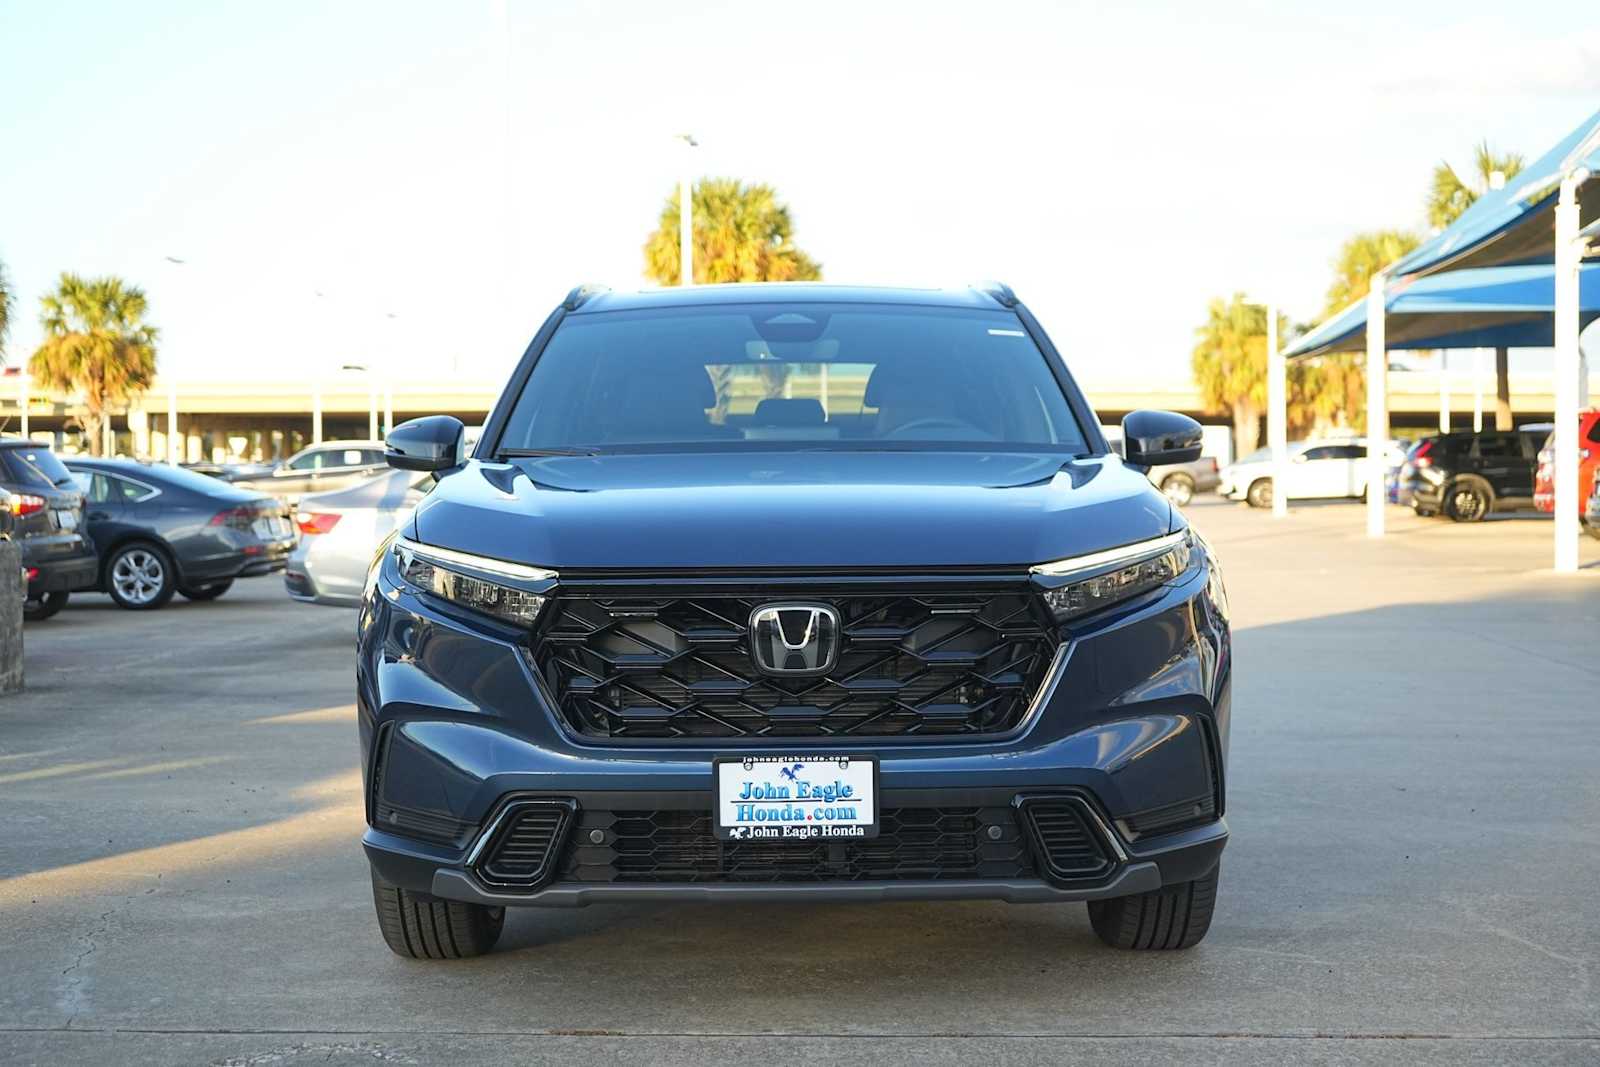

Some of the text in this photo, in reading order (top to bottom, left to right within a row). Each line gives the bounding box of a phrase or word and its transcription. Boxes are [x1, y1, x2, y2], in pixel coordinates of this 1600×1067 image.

[739, 780, 853, 803] John Eagle
[736, 804, 857, 822] Honda.com
[747, 824, 865, 839] John Eagle Honda
